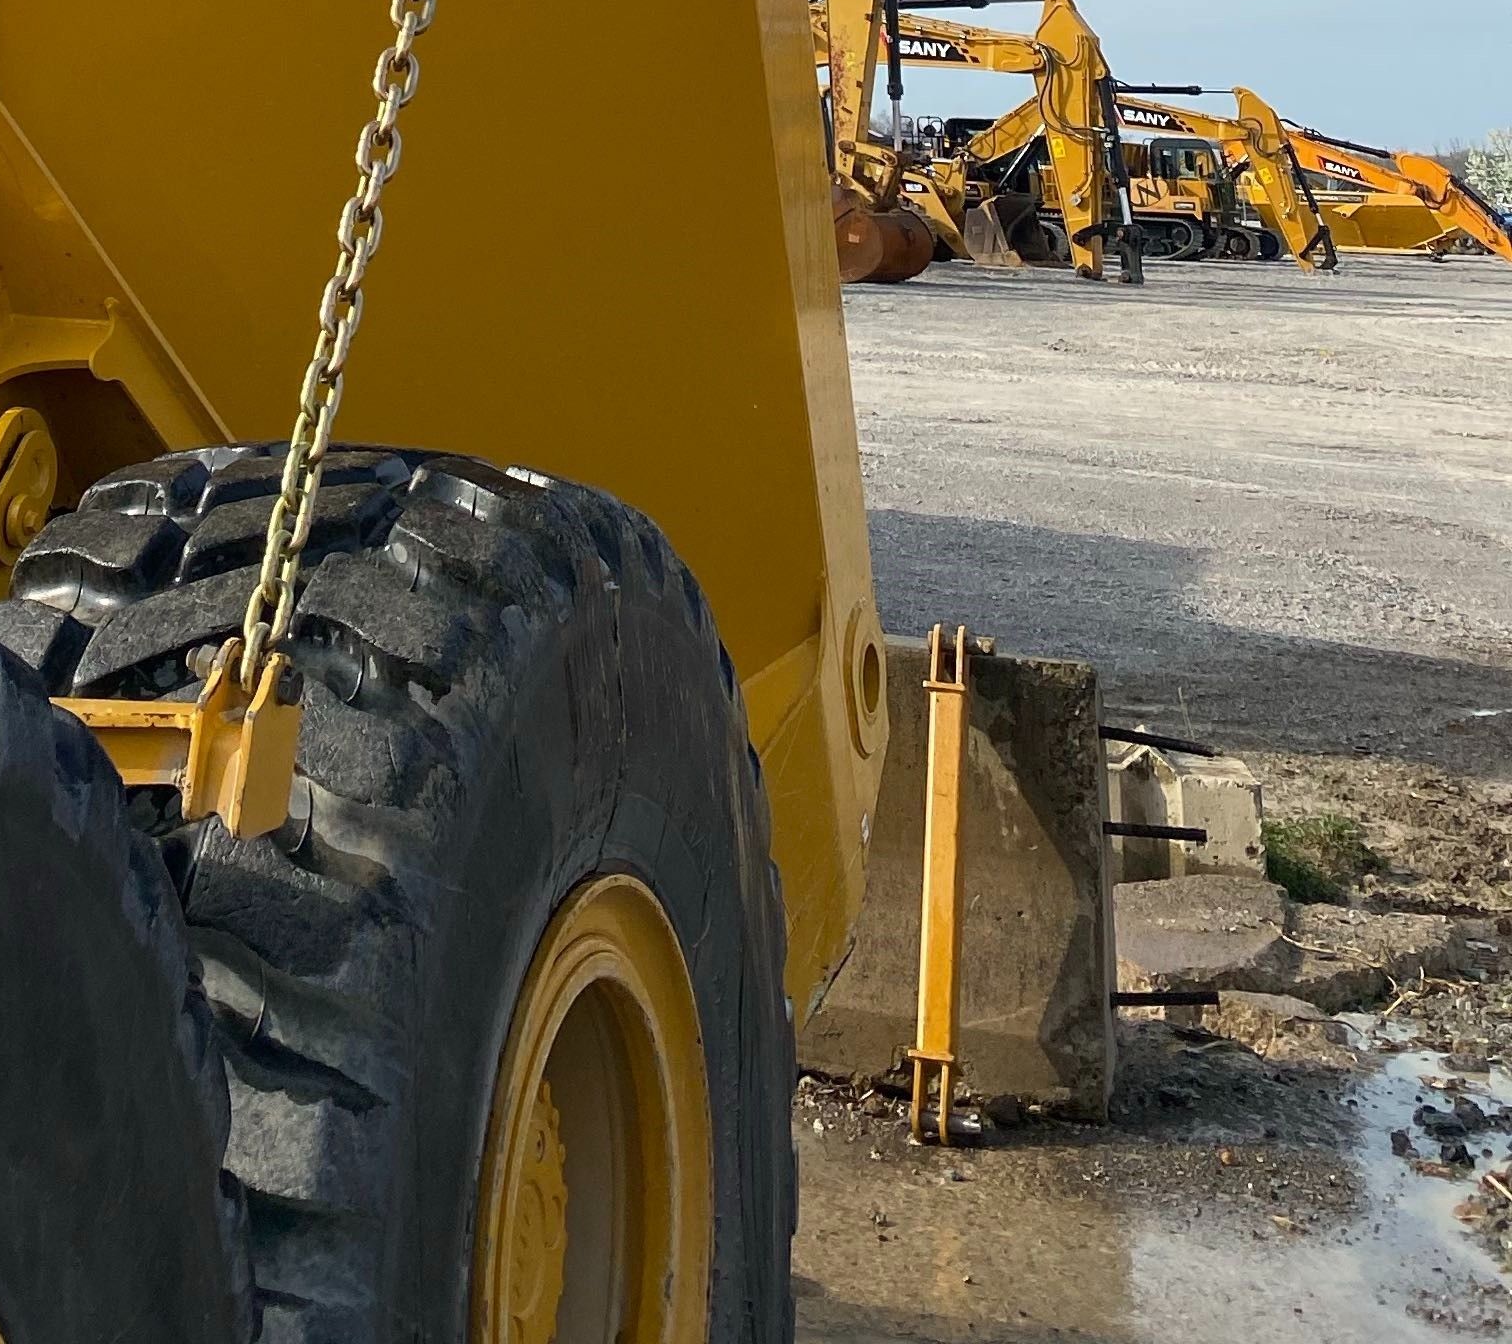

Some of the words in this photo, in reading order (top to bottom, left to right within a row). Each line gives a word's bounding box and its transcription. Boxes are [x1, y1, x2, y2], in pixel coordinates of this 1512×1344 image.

[899, 39, 951, 58] SANY
[1123, 109, 1170, 127] SANY
[1325, 162, 1360, 178] SANY
